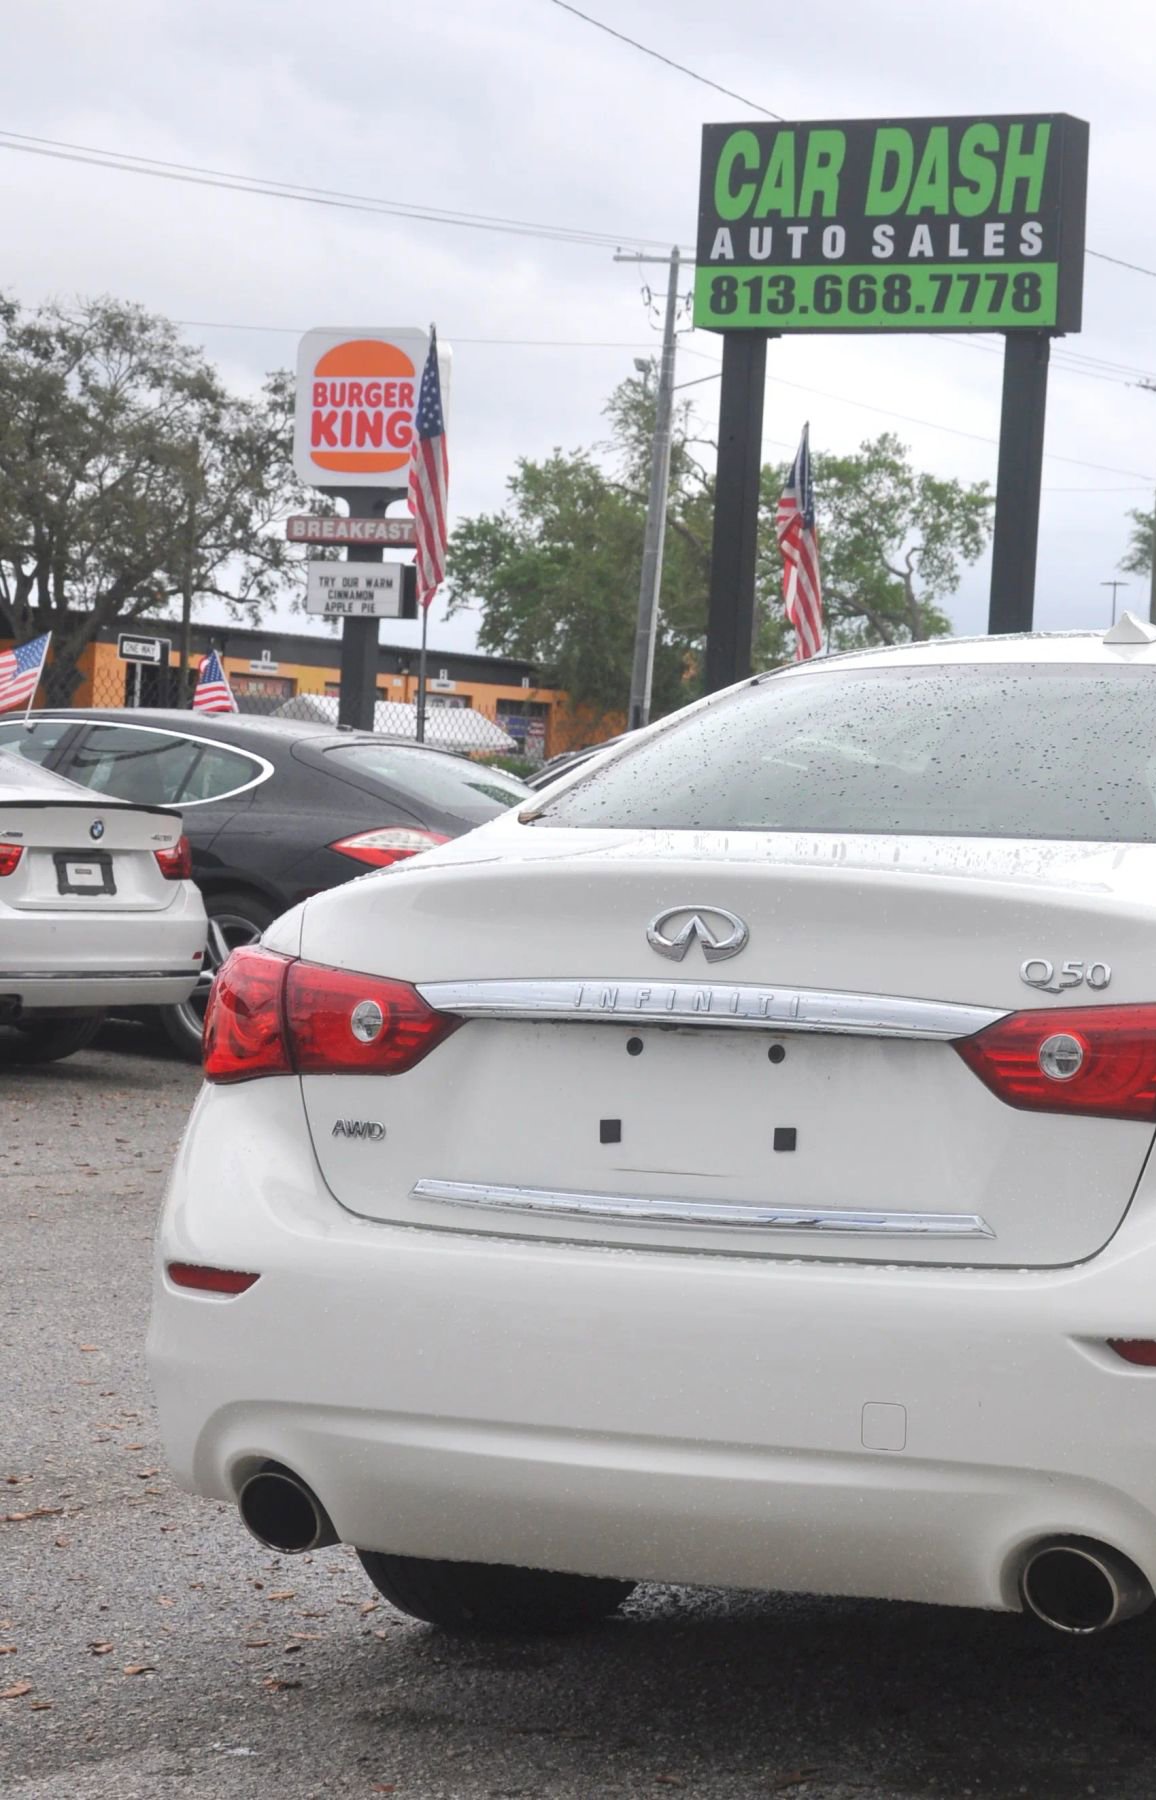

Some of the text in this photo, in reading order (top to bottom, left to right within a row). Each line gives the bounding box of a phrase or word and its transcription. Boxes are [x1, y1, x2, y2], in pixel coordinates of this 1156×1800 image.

[714, 122, 1052, 220] CAR DASH
[709, 221, 1043, 260] AUTO SALES
[709, 271, 1042, 315] 813.668.7778
[312, 382, 415, 408] BURGER
[311, 410, 413, 448] KING
[292, 519, 414, 540] BREAKFAST
[319, 576, 393, 588] TRY OUR WARM
[328, 589, 374, 600] CINNAMON
[324, 601, 376, 613] APPLE PIE
[1020, 958, 1112, 993] Q50
[575, 986, 799, 1018] INFINITI
[332, 1119, 386, 1141] AWD
